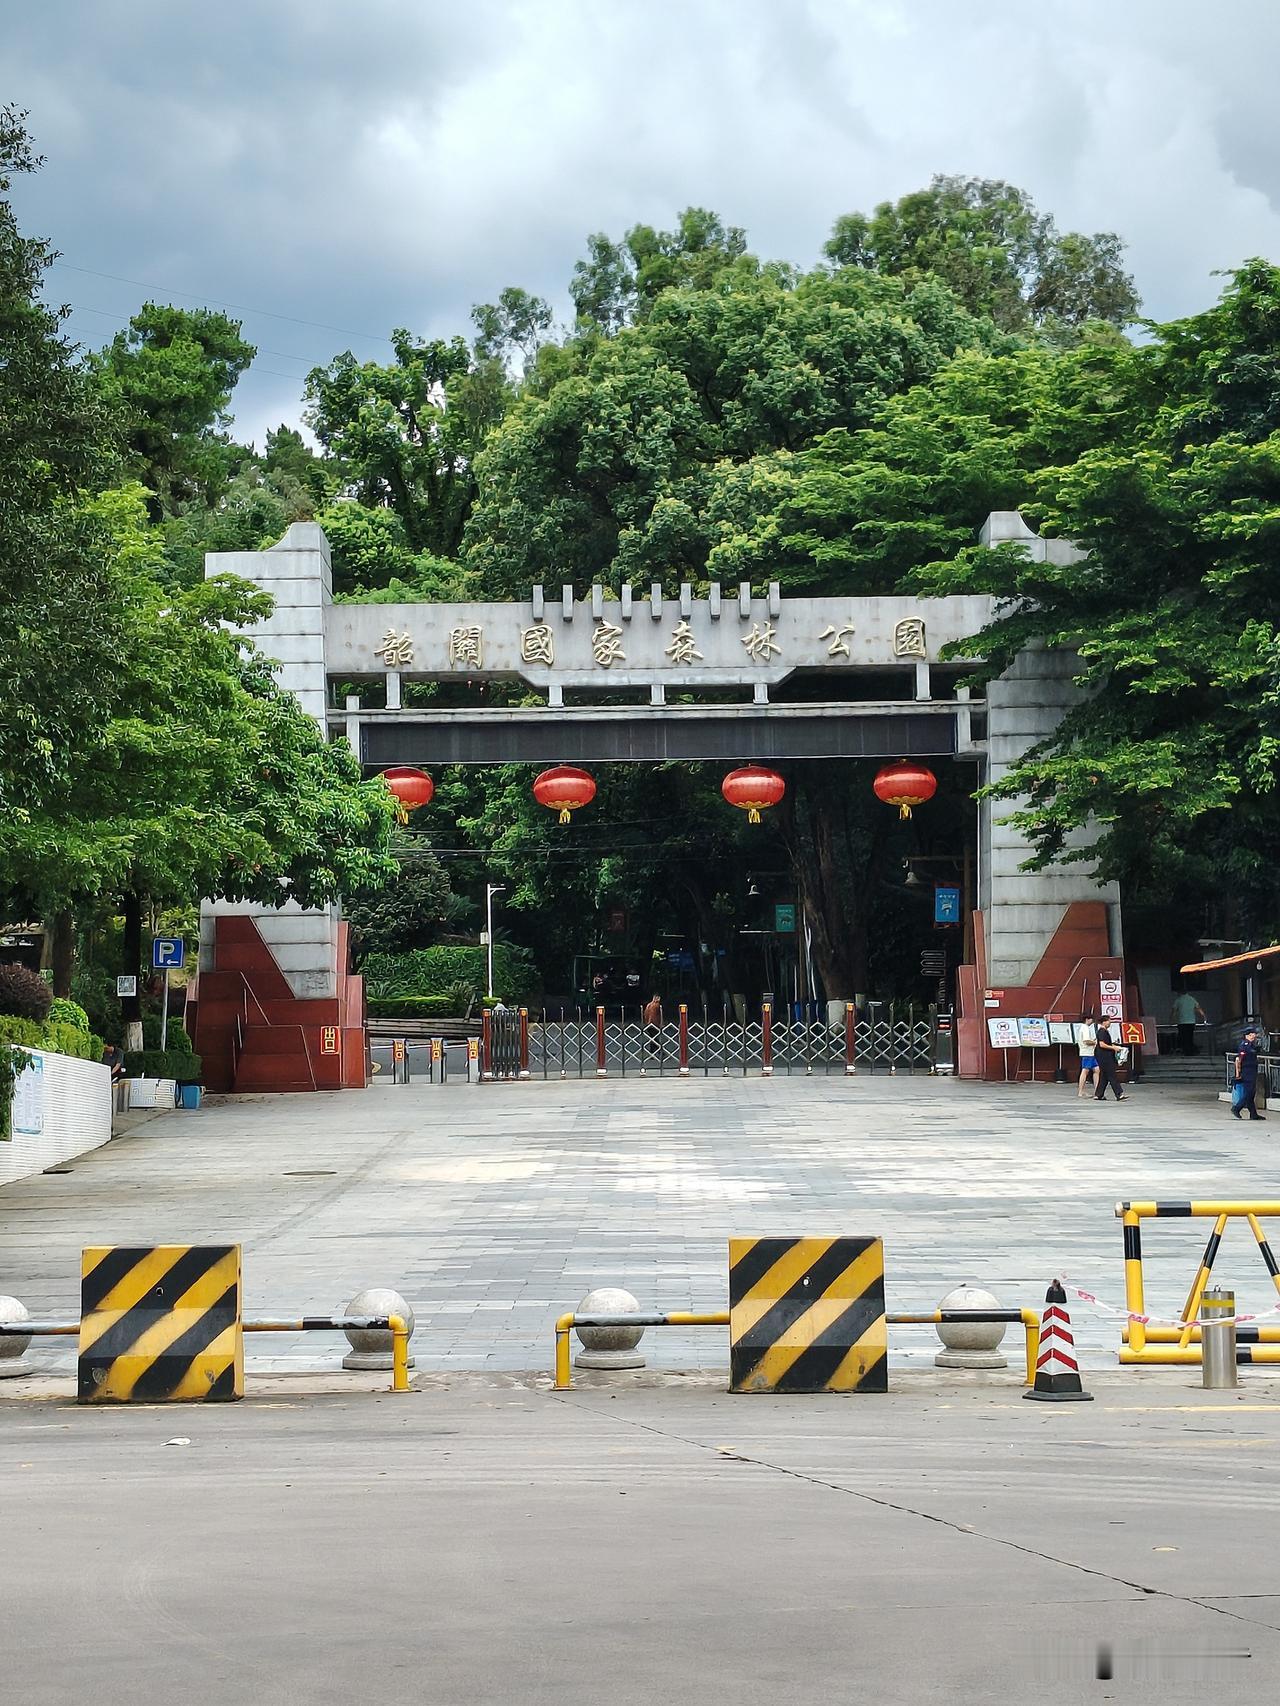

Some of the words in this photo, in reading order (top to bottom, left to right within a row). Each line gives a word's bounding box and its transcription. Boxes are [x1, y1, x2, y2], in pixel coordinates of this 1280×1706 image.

[374, 616, 926, 669] 韶關國家森林公園
[159, 942, 175, 963] P
[324, 1027, 336, 1050] 出口
[1126, 1023, 1140, 1043] 入口
